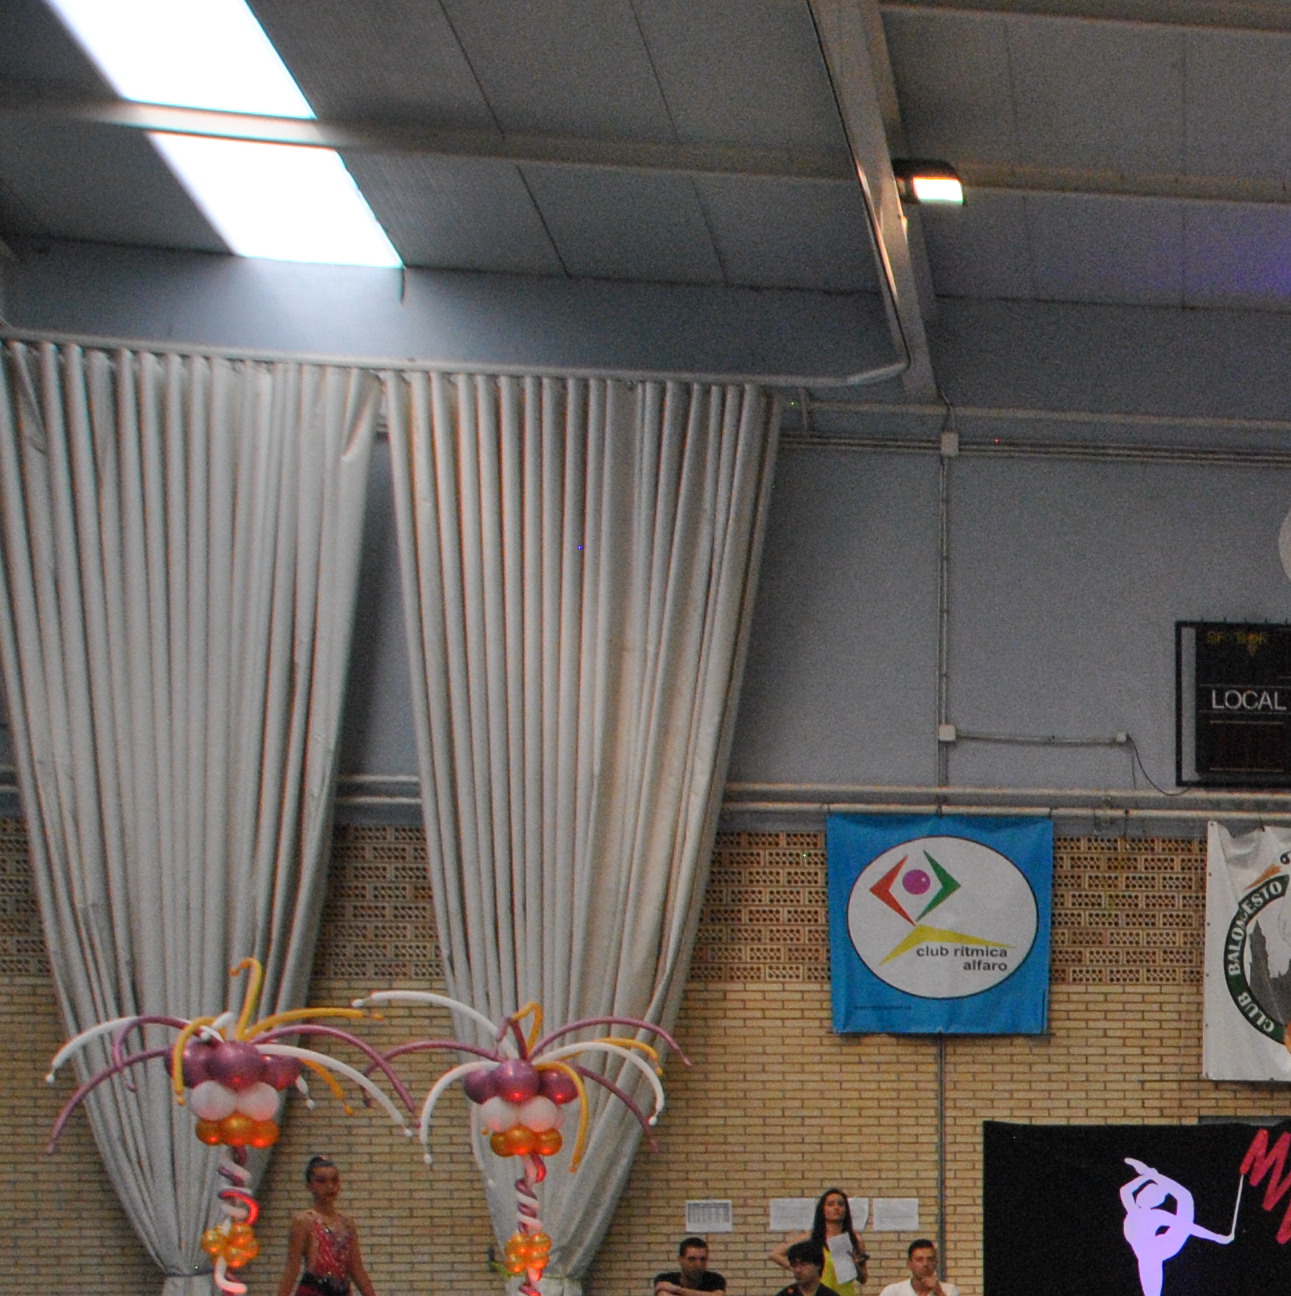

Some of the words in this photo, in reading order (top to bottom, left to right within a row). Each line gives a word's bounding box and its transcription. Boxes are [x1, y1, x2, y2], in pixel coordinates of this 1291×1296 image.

[1212, 689, 1287, 711] LOCAL
[916, 946, 948, 957] club
[963, 960, 1007, 971] alfaro
[1238, 992, 1274, 1032] CLUB
